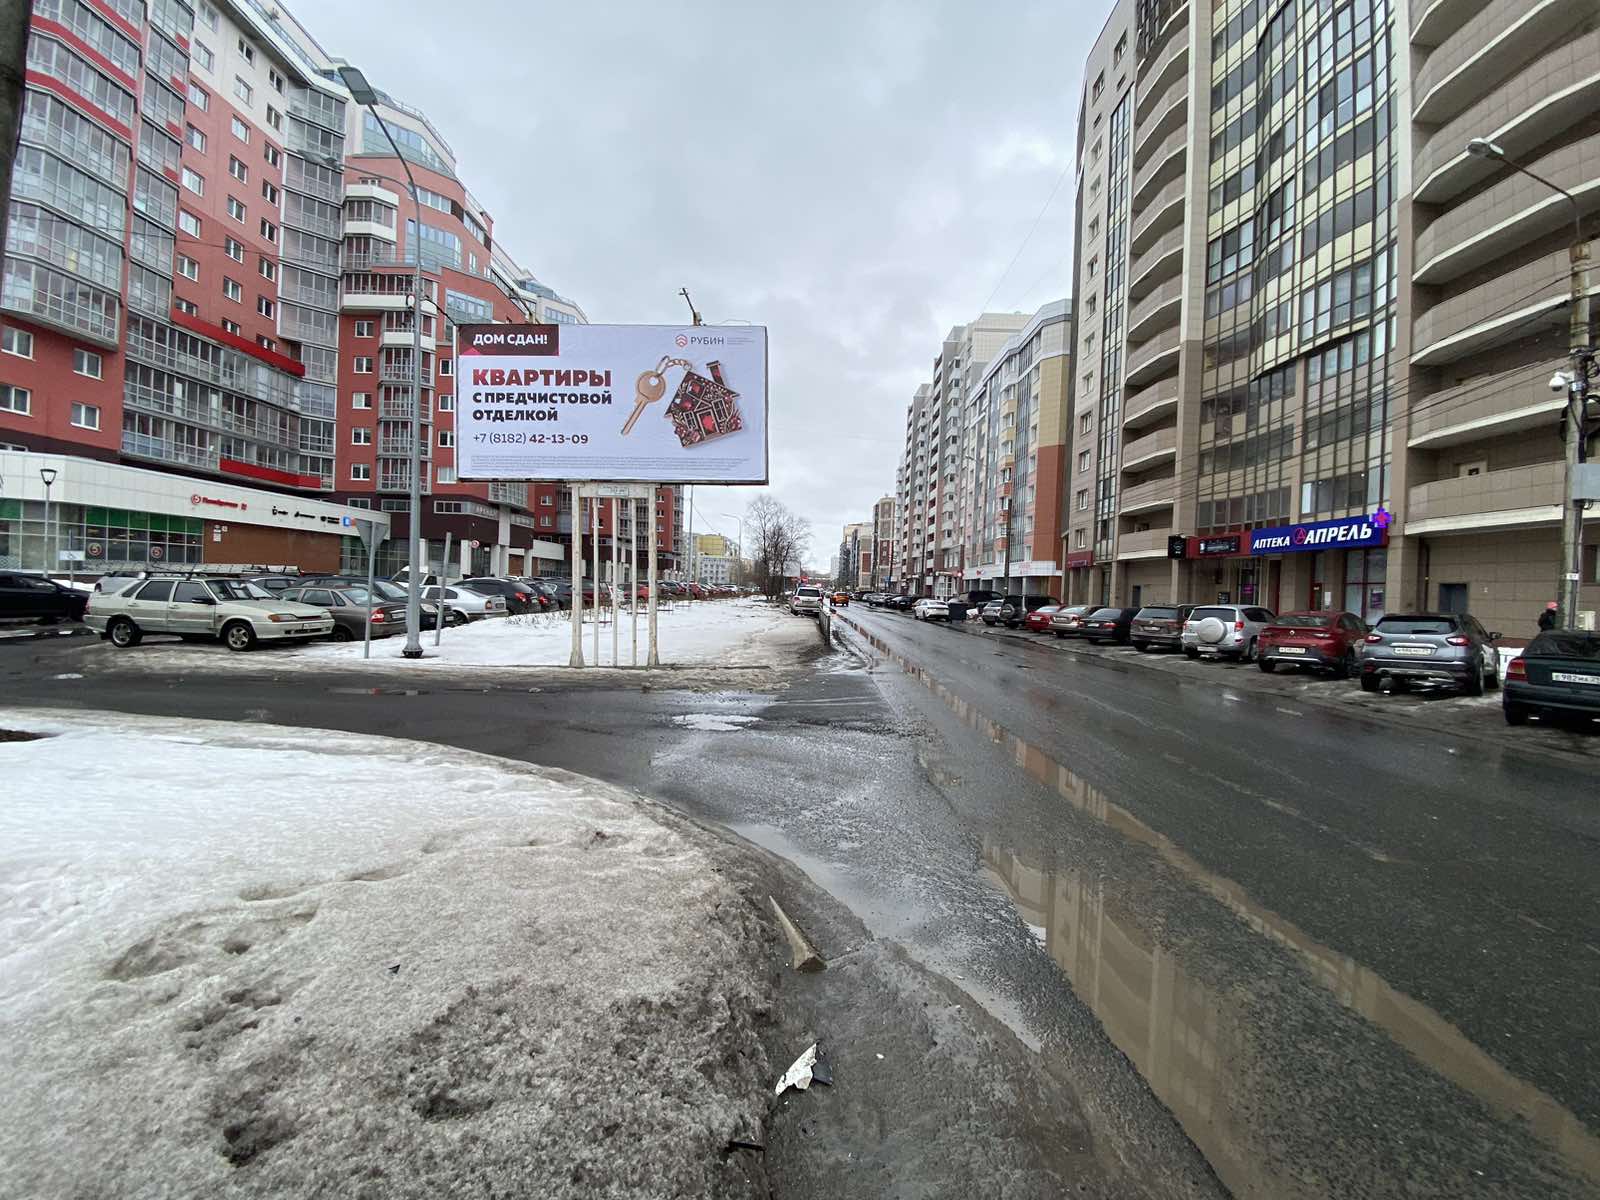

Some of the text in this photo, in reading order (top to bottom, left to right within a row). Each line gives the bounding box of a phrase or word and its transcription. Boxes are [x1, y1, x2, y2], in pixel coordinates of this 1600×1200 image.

[473, 334, 548, 346] ДОМ СДАН!
[690, 336, 725, 345] РУБИН
[473, 369, 612, 387] КВАРТИРЫ
[472, 390, 612, 405] С ПРЕДЧИСТОВОЙ
[472, 407, 558, 422] ОТДЕЛКОЙ
[473, 432, 589, 444] +7 (8182) 42-13-09
[1253, 536, 1290, 549] АПТЕКА
[1304, 523, 1372, 544] АПРЕЛЬ
